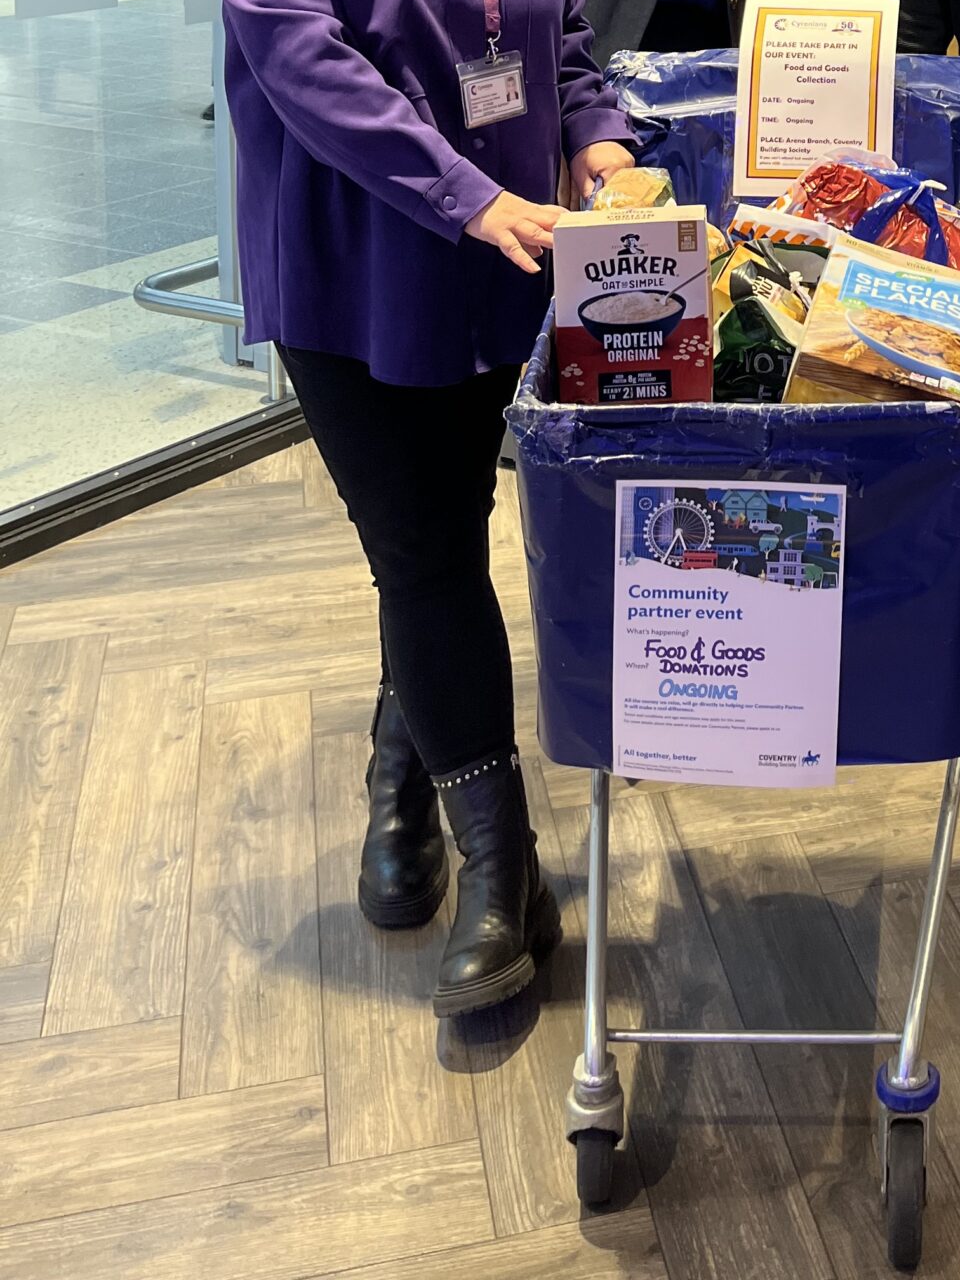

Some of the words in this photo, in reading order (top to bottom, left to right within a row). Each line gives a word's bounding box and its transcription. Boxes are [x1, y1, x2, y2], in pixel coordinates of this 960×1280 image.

[784, 63, 804, 71] Food
[824, 64, 849, 72] Goods
[796, 75, 836, 83] Collection
[584, 256, 678, 282] QUAKER
[602, 281, 621, 290] OAT
[629, 278, 664, 288] SIMPLE
[603, 330, 662, 349] PROTEIN
[607, 348, 660, 362] ORIGINAL
[636, 385, 666, 398] MINS
[628, 584, 728, 604] Community
[627, 606, 691, 620] partner
[695, 607, 743, 620] event
[650, 628, 689, 637] happening?
[691, 637, 705, 663] &
[635, 750, 671, 760] together,
[672, 753, 696, 761] better
[759, 754, 797, 762] COVENTRY
